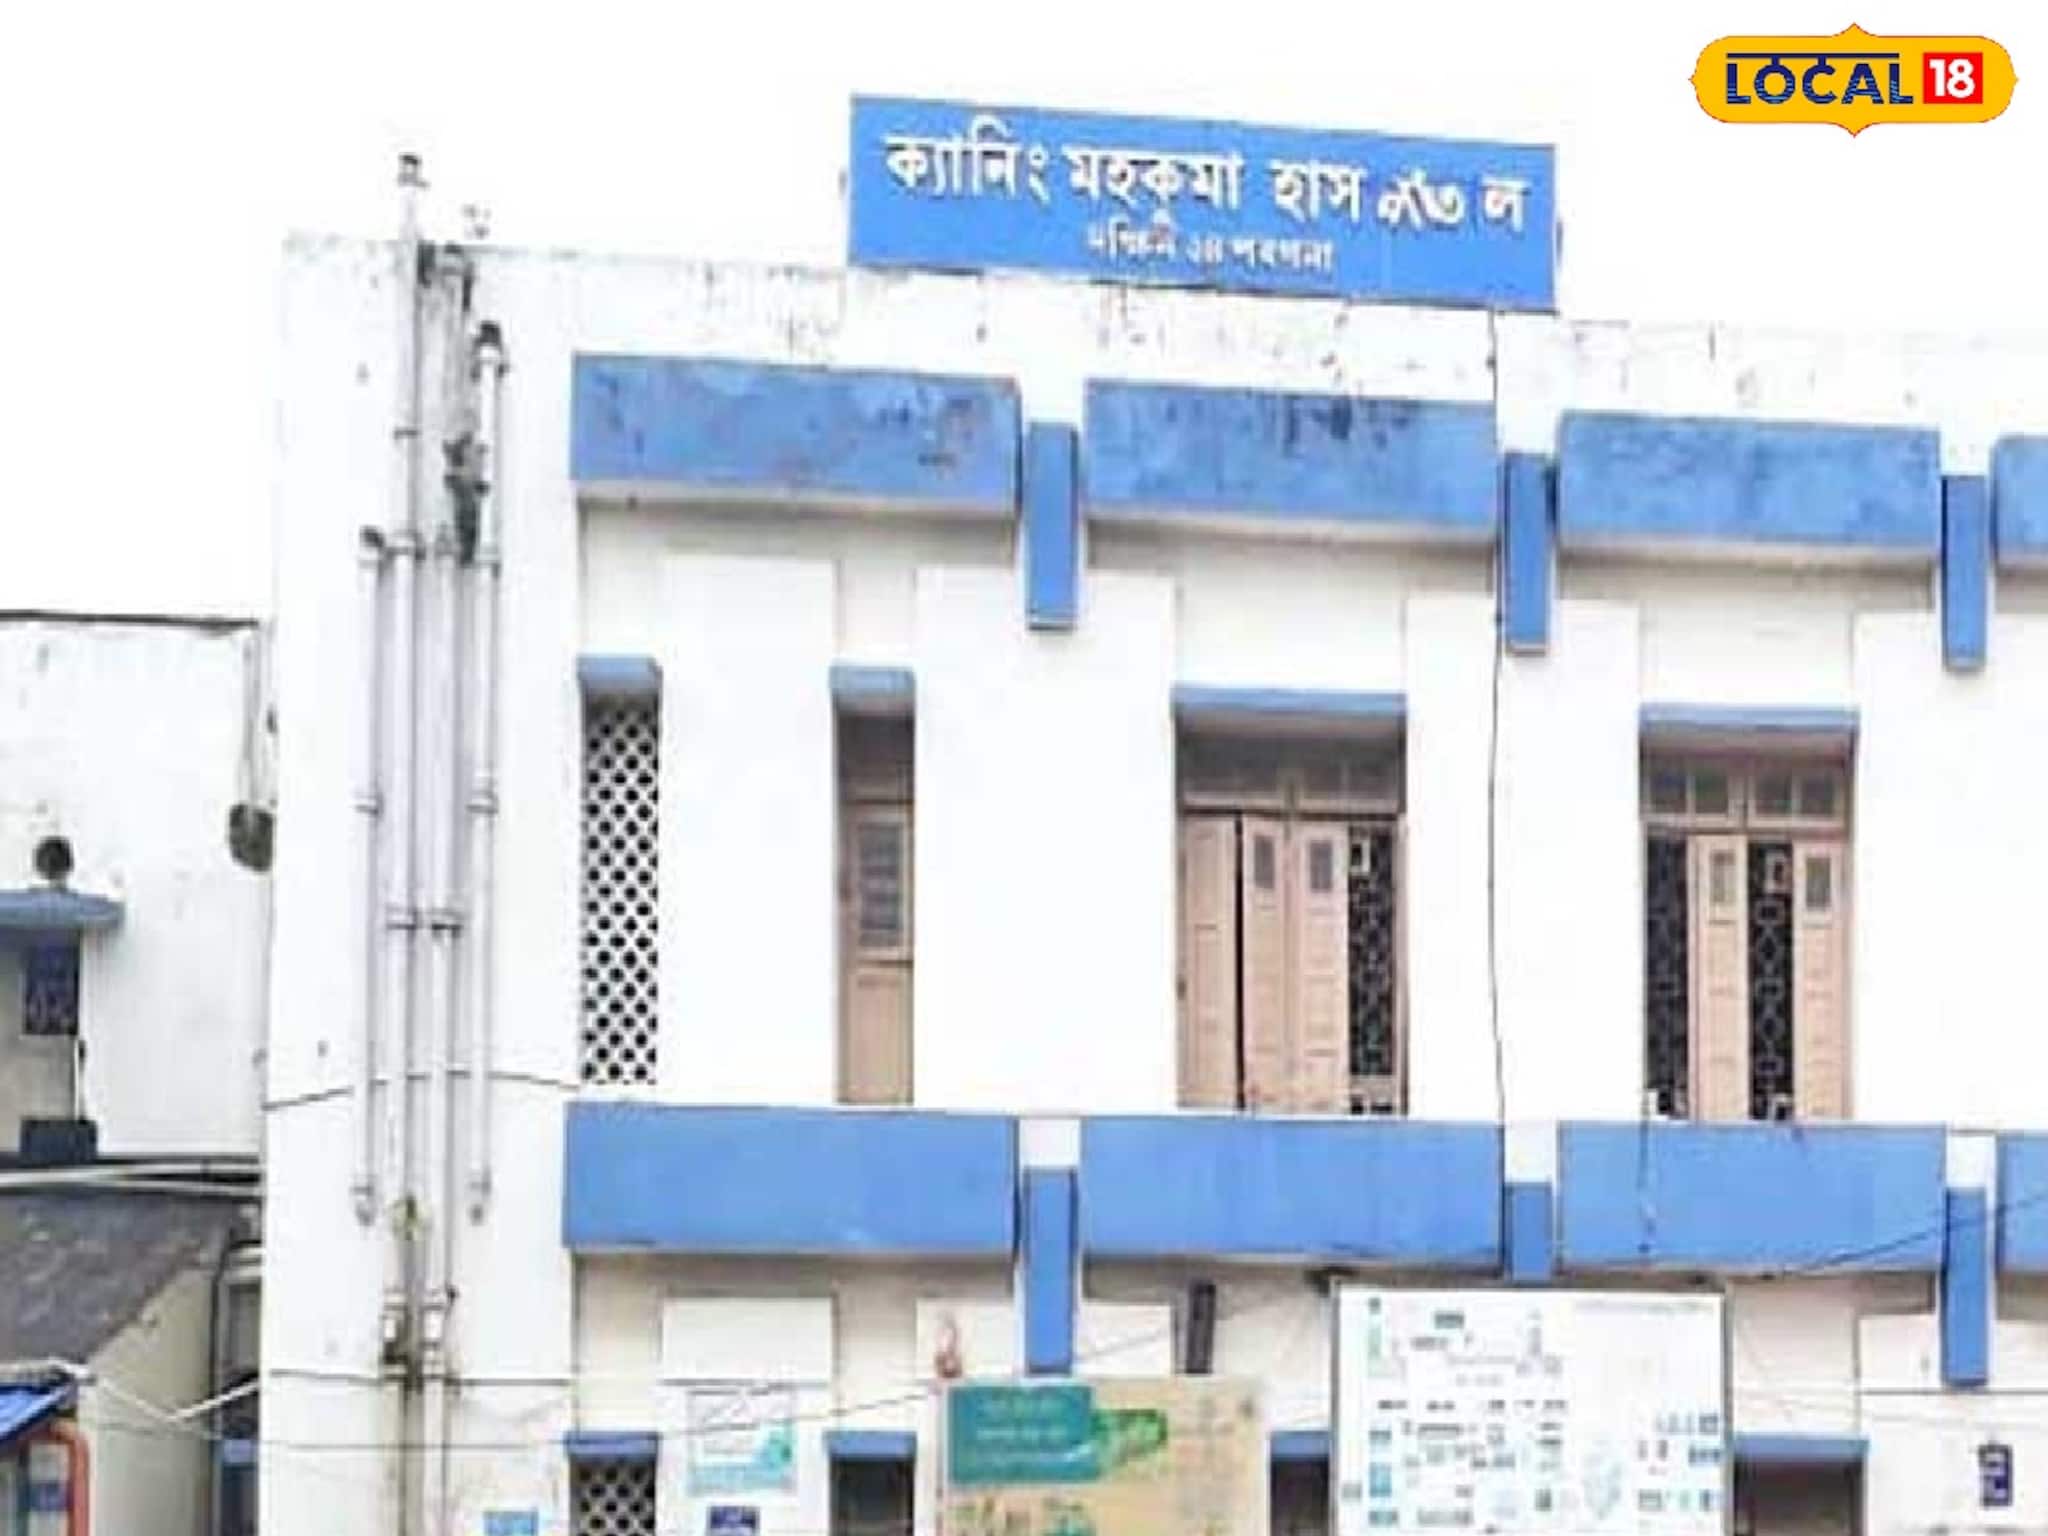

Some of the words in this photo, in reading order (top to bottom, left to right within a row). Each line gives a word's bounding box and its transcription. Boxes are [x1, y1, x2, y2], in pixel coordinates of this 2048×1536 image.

[882, 114, 1049, 202] ক্যানিং
[1062, 145, 1244, 218] মহকুমা
[1268, 157, 1532, 232] হাসপাতল
